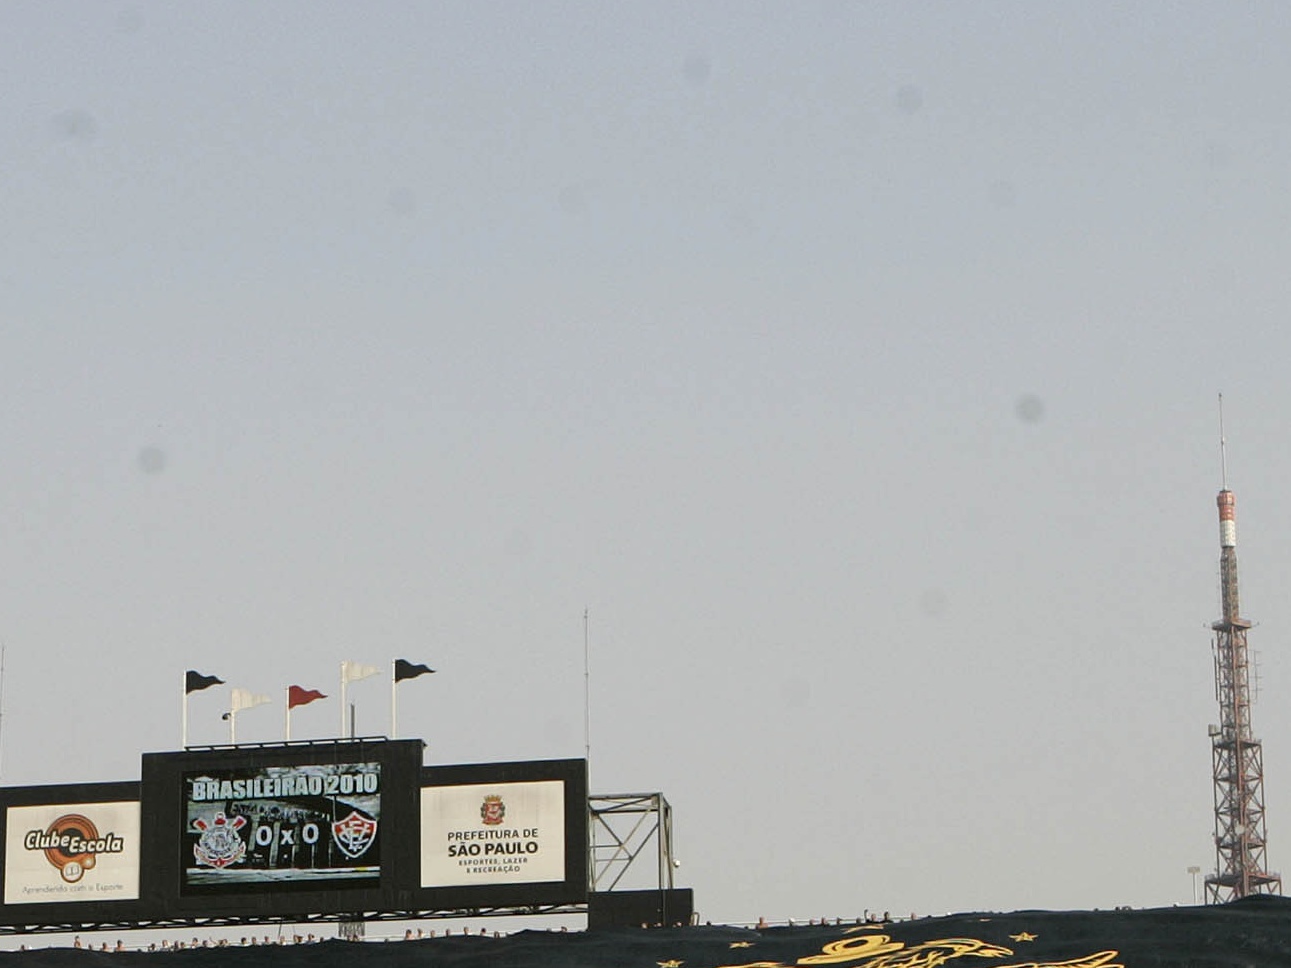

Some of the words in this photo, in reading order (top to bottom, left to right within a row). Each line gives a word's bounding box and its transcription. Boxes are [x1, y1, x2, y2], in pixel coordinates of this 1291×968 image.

[327, 773, 378, 795] 2010
[448, 829, 519, 841] PREFEITURA
[523, 828, 539, 838] DE
[448, 842, 481, 857] SÃO
[485, 842, 539, 855] PAULO
